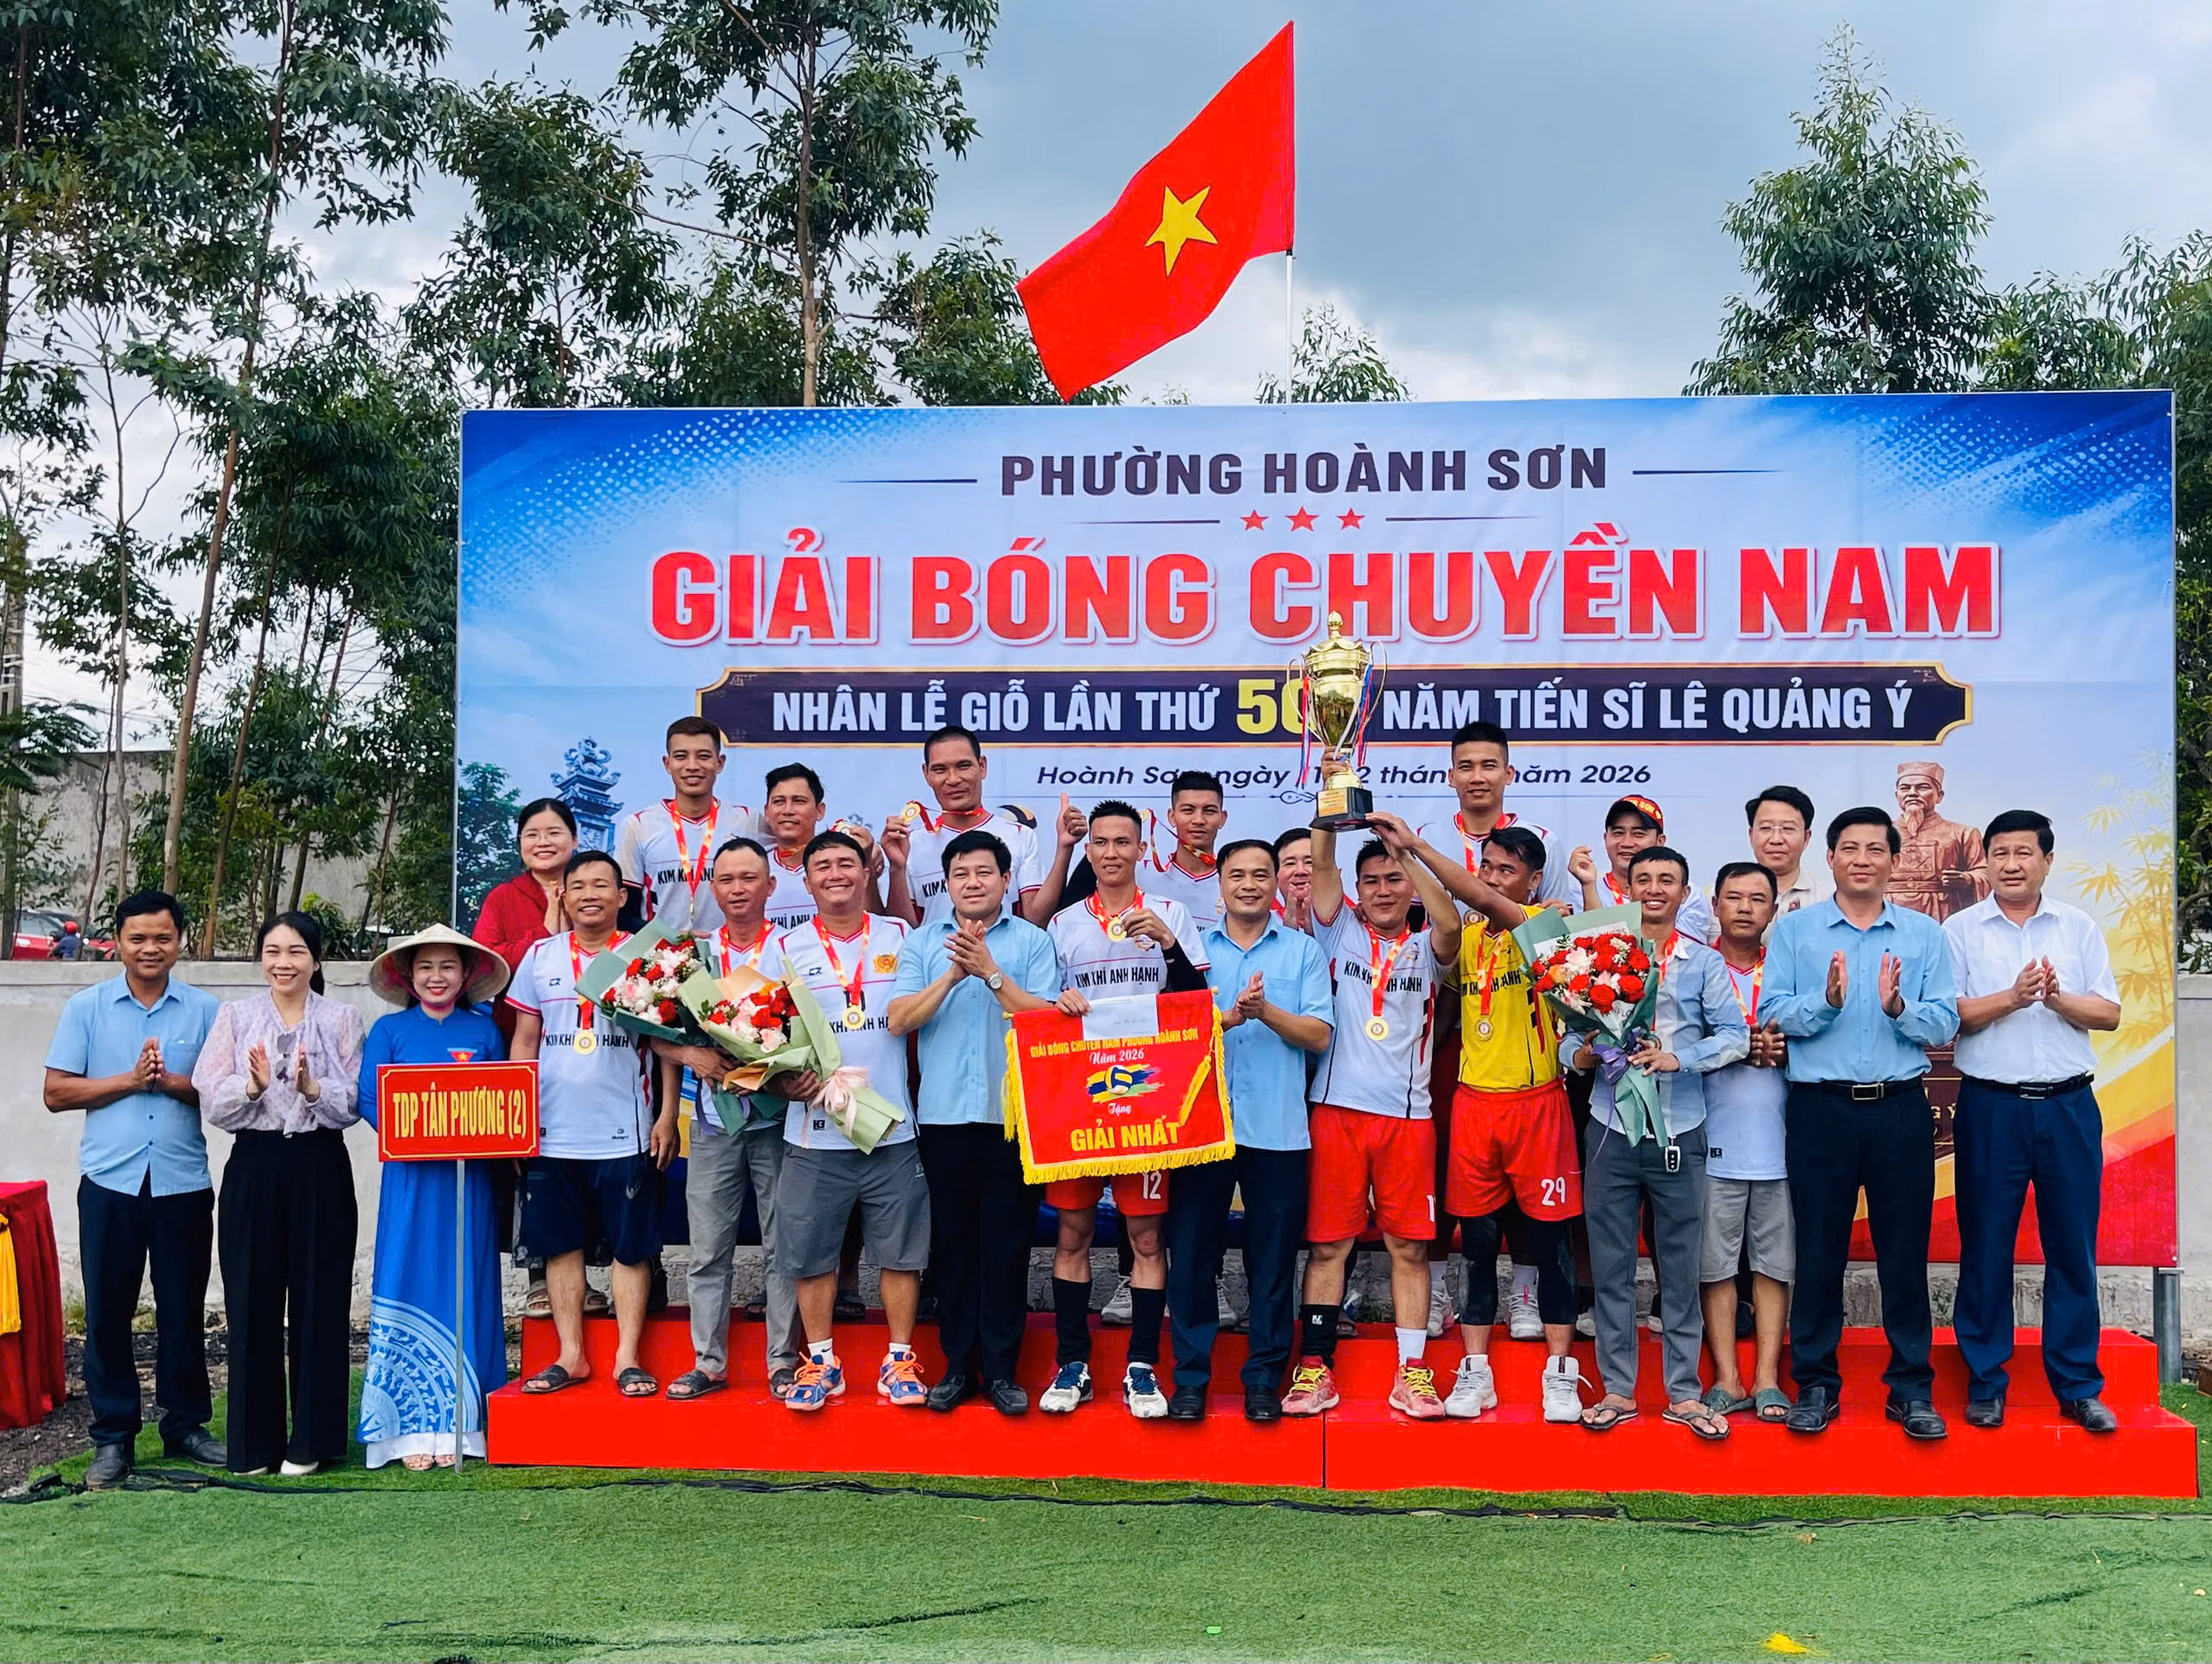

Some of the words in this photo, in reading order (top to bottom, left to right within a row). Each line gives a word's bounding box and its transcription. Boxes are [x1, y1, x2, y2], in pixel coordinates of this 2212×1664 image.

[1002, 445, 1242, 496] PHƯỜNG
[1264, 442, 1467, 493] HOÀNH
[1487, 444, 1606, 490] SƠN
[649, 526, 873, 642] GIẢI
[909, 536, 1211, 642] BÓNG
[1248, 521, 1700, 640] CHUYỀN
[1738, 545, 2000, 636] NAM
[773, 684, 886, 732] NHÂN
[901, 679, 948, 732] LỄ
[961, 678, 1030, 731] GIỖ
[1043, 679, 1122, 732] LẦN
[1135, 682, 1221, 732] THỨ
[1237, 678, 1319, 735] 50
[1384, 682, 1480, 730] NĂM
[1494, 677, 1589, 729] TIẾN
[1602, 681, 1647, 729] SĨ
[1659, 680, 1708, 729] LÊ
[1722, 676, 1871, 733] QUẢNG
[1885, 680, 1913, 729] Ý
[1037, 765, 1134, 785] Hoành
[1142, 765, 1180, 784] Sơ
[1216, 765, 1291, 788] ngày
[1380, 765, 1448, 784] thán
[1579, 765, 1652, 784] 2026
[657, 868, 676, 885] KIM
[1109, 968, 1128, 984] ANH
[1131, 967, 1160, 986] HẠNH
[1118, 1047, 1145, 1062] 2026
[392, 1091, 419, 1138] TDP
[420, 1081, 448, 1137] TÂN
[450, 1085, 505, 1137] PHƯƠNG
[508, 1088, 527, 1140] (2)
[1108, 1102, 1132, 1117] Tặng
[1071, 1117, 1116, 1152] GIẢI
[1120, 1114, 1180, 1149] NHẤT
[1142, 1172, 1163, 1200] 12
[1540, 1175, 1566, 1206] 29
